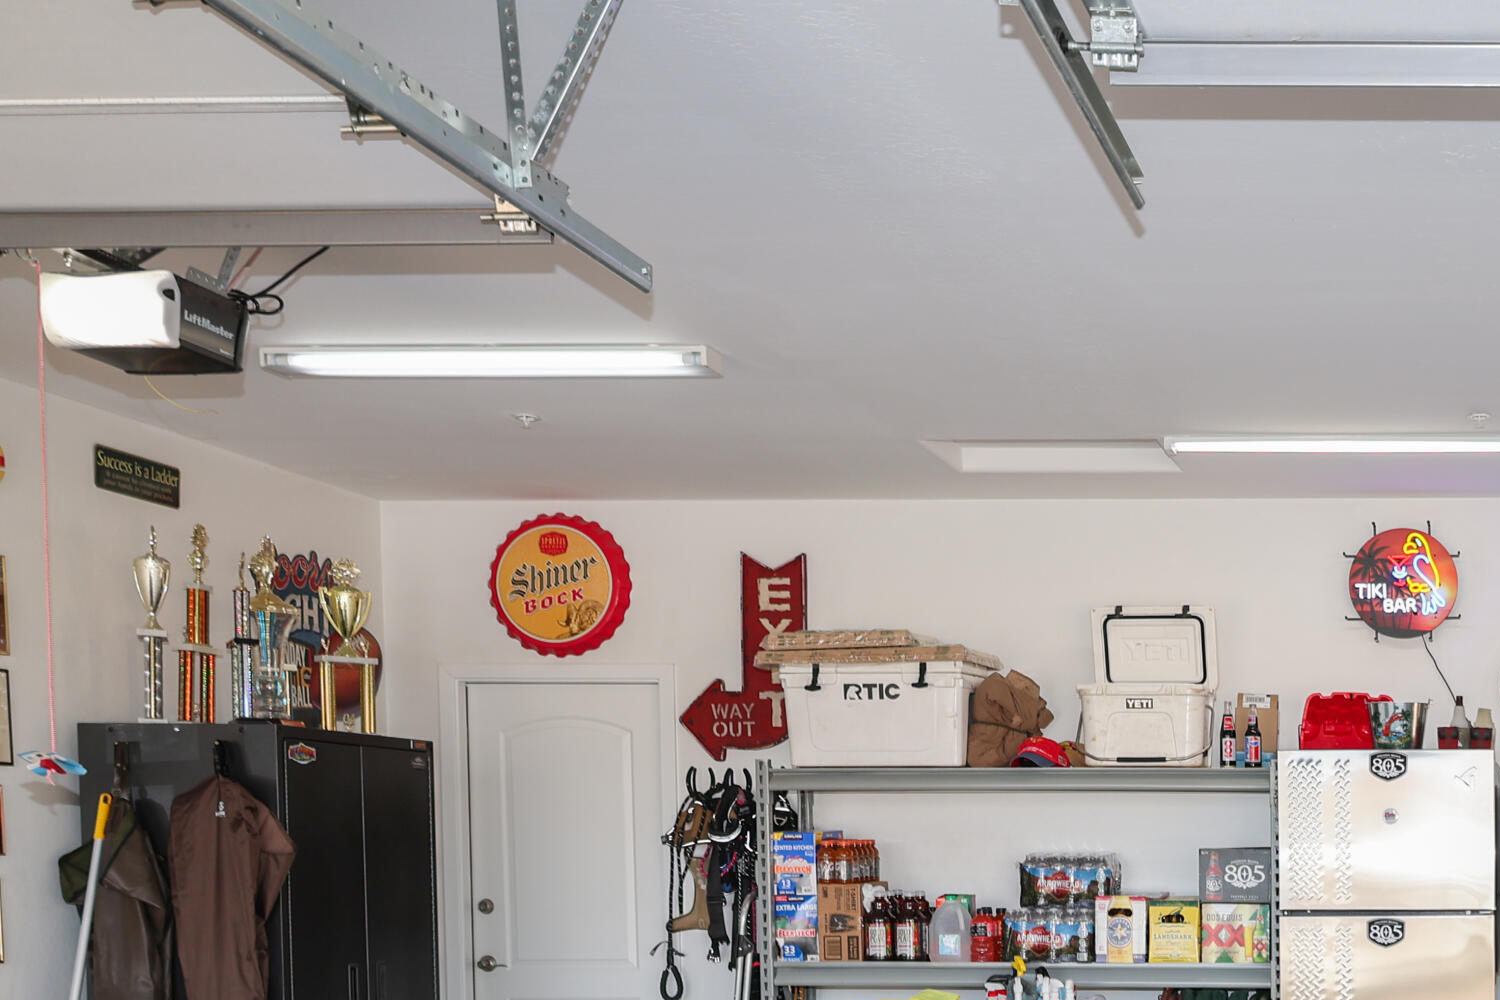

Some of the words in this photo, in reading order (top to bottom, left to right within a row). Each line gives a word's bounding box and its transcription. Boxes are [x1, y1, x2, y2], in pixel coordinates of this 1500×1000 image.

[184, 309, 234, 340] LiftMaster
[97, 449, 133, 474] Success
[134, 461, 142, 477] is
[143, 467, 150, 479] a
[151, 466, 178, 488] Ladder
[509, 556, 598, 602] Shiner
[1355, 583, 1387, 599] TIKI
[523, 588, 585, 614] BOCK
[1383, 597, 1418, 613] BAR
[1123, 642, 1190, 662] YETI
[843, 683, 900, 700] RTIC
[711, 703, 755, 719] WAY
[1126, 700, 1152, 708] YETI
[713, 721, 755, 737] OUT
[1372, 758, 1405, 773] 805
[1224, 865, 1265, 883] 805
[782, 880, 791, 888] 13
[1036, 879, 1080, 890] ARROWHEAD
[1016, 934, 1060, 944] ARROWHEAD
[1370, 925, 1402, 939] 805
[784, 945, 795, 954] 33
